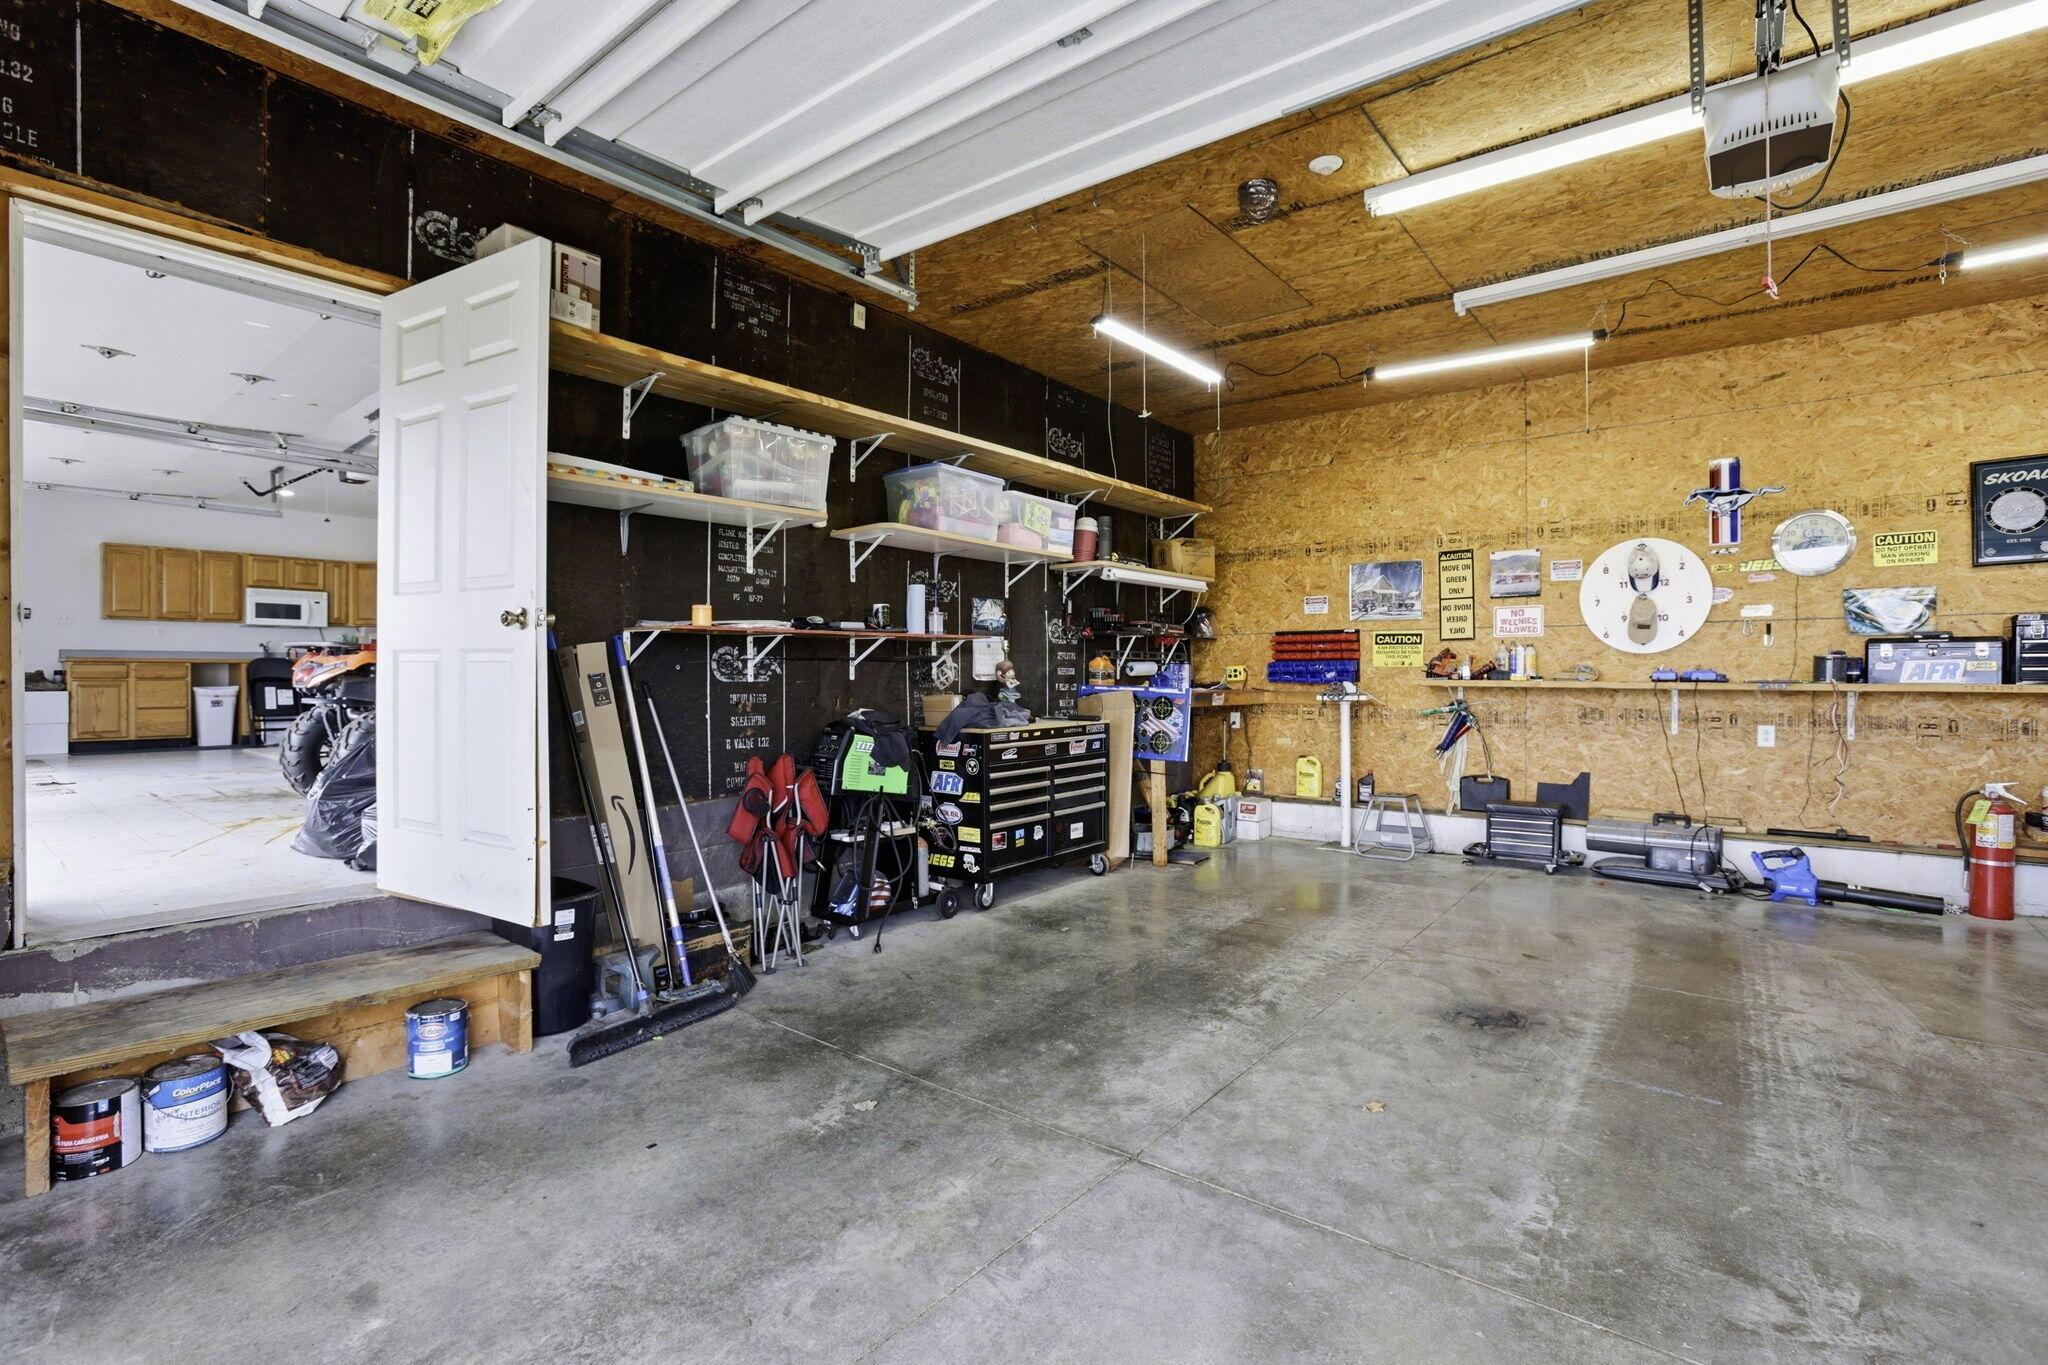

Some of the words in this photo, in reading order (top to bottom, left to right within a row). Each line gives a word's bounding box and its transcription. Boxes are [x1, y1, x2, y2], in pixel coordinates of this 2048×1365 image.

[1876, 533, 1935, 546] CAUTION
[1442, 564, 1459, 572] MOVE
[1511, 609, 1525, 617] NO
[1500, 617, 1538, 626] WEENIES
[1376, 635, 1420, 643] CAUTION
[1907, 662, 1961, 681] AFR
[933, 774, 960, 792] AFR
[928, 853, 955, 868] JEGS
[172, 1077, 222, 1097] ColorPlace
[176, 1100, 221, 1118] INTERIOR
